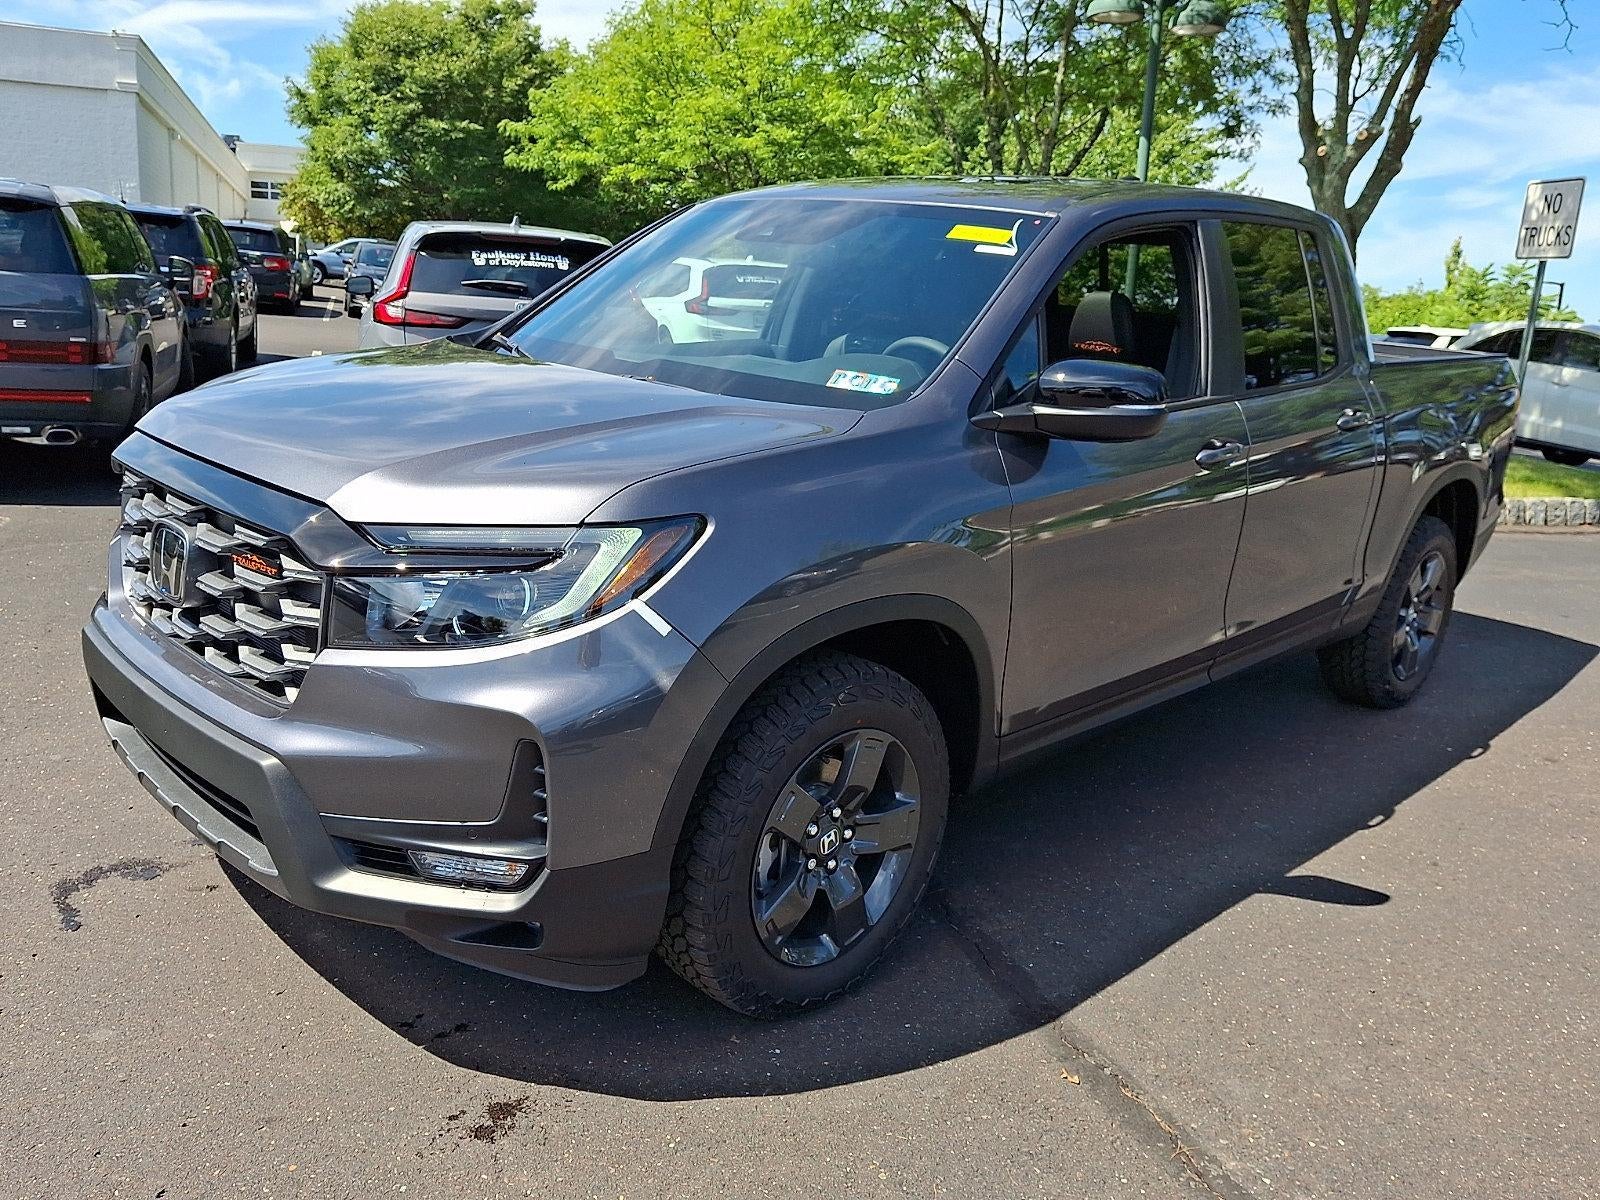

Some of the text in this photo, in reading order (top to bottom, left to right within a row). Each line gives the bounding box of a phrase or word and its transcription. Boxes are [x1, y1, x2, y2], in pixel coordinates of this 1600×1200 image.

[1541, 193, 1563, 215] NO
[1522, 225, 1572, 248] TRUCKS
[489, 258, 500, 266] of
